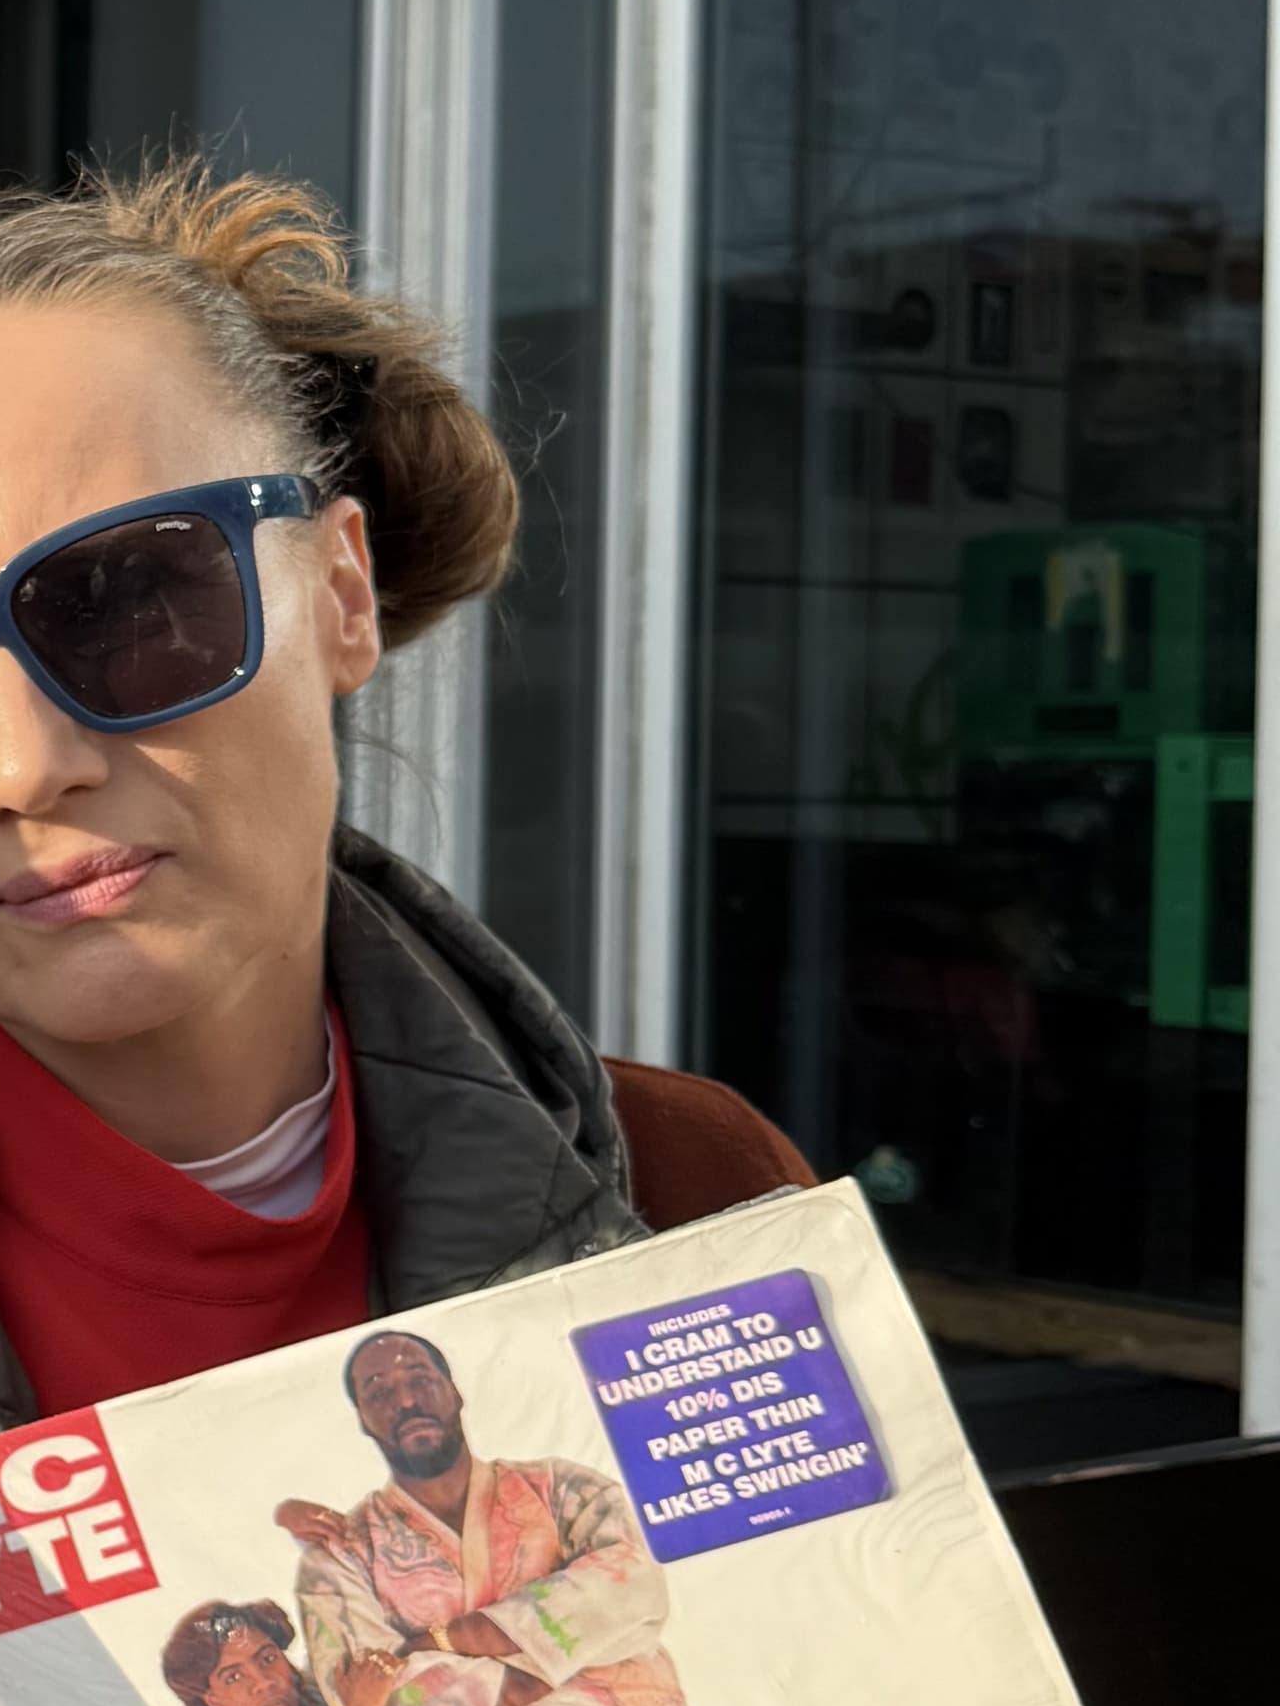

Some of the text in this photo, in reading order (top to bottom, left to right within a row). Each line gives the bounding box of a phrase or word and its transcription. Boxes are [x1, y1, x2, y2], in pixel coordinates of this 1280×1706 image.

[625, 1313, 776, 1371] I CRAM TO
[648, 1304, 733, 1337] INCLUDES
[597, 1327, 823, 1405] UNDERSTAND U
[665, 1372, 785, 1421] 10% DIS
[647, 1394, 825, 1461] PAPER THIN
[643, 1442, 869, 1525] LIKES SWINGIN'
[681, 1430, 816, 1485] M C LYTE
